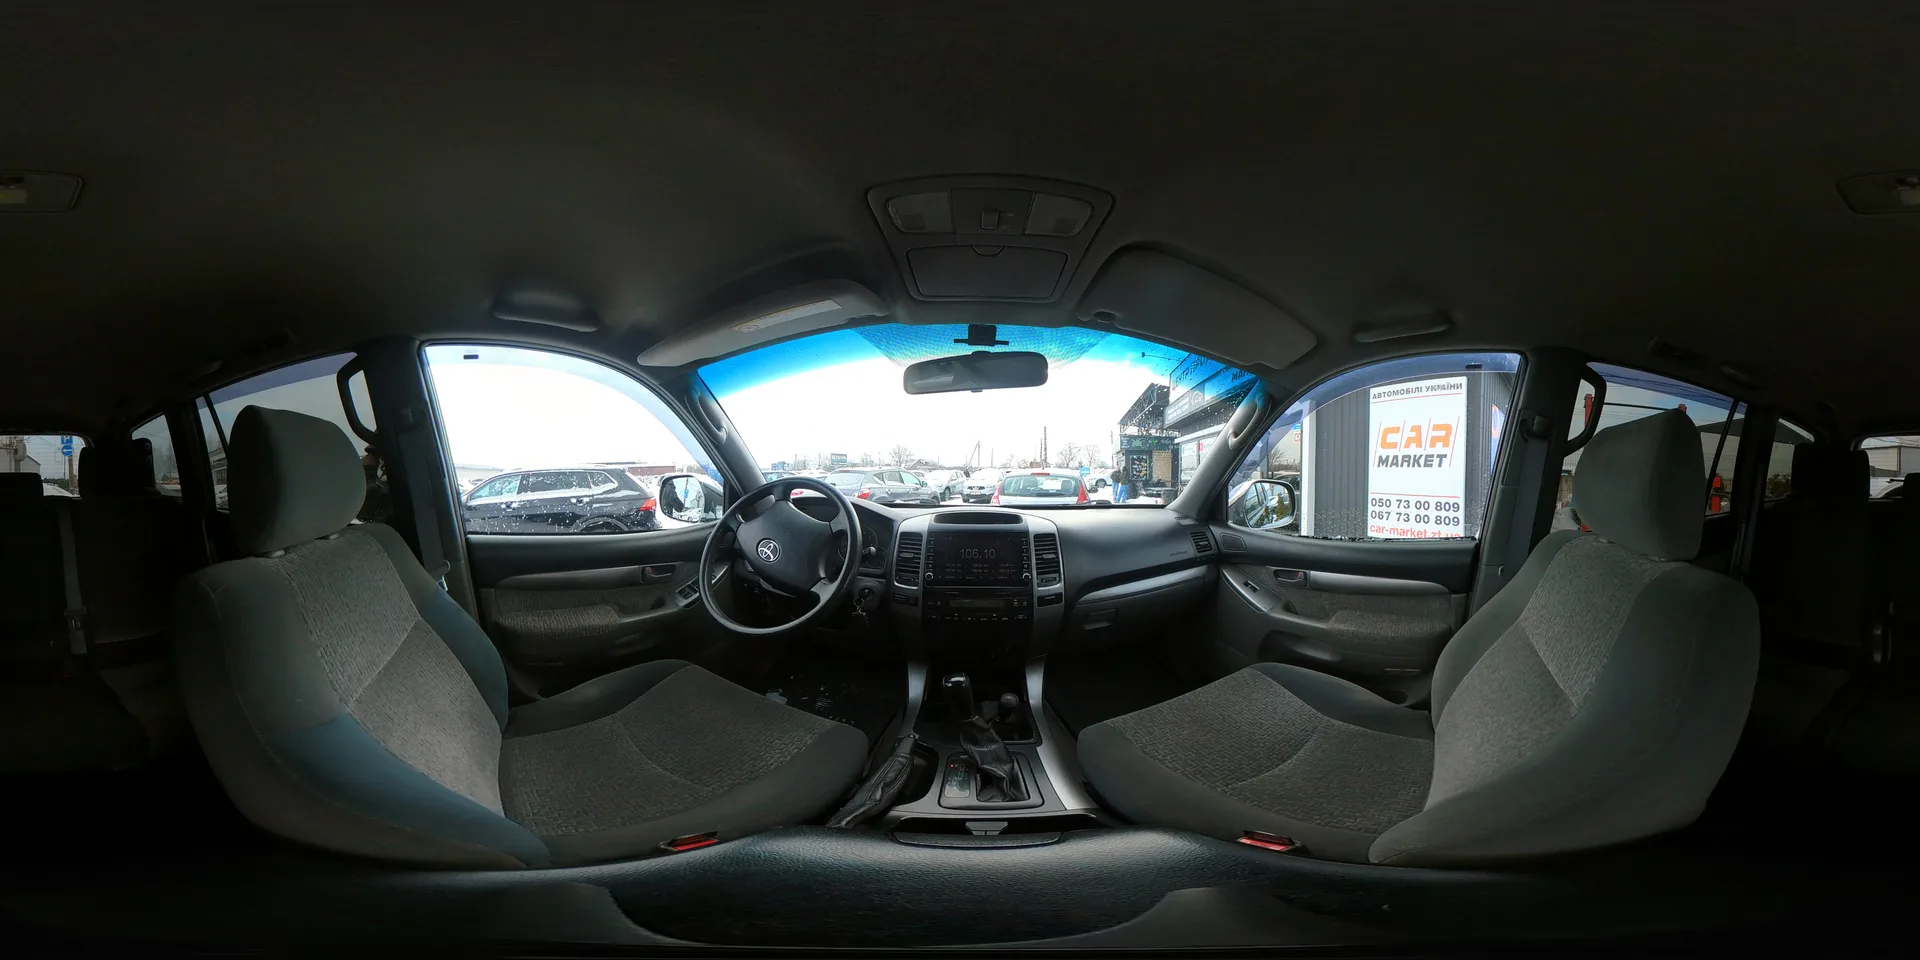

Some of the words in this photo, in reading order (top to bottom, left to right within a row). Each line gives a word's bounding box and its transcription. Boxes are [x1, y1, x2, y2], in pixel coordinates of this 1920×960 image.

[1372, 386, 1422, 399] АВТОМОБІЛІ
[1425, 382, 1463, 393] УКРАЇНИ
[1380, 423, 1453, 449] CAR
[1377, 453, 1447, 468] MARKET
[1370, 498, 1391, 508] 050
[1396, 499, 1410, 509] 73
[1414, 500, 1430, 510] 00
[1434, 501, 1460, 512] 809
[1370, 510, 1391, 520] 067
[1396, 512, 1410, 522] 73
[1414, 514, 1430, 524] 00
[1434, 515, 1460, 526] 809
[960, 548, 995, 559] 106.10
